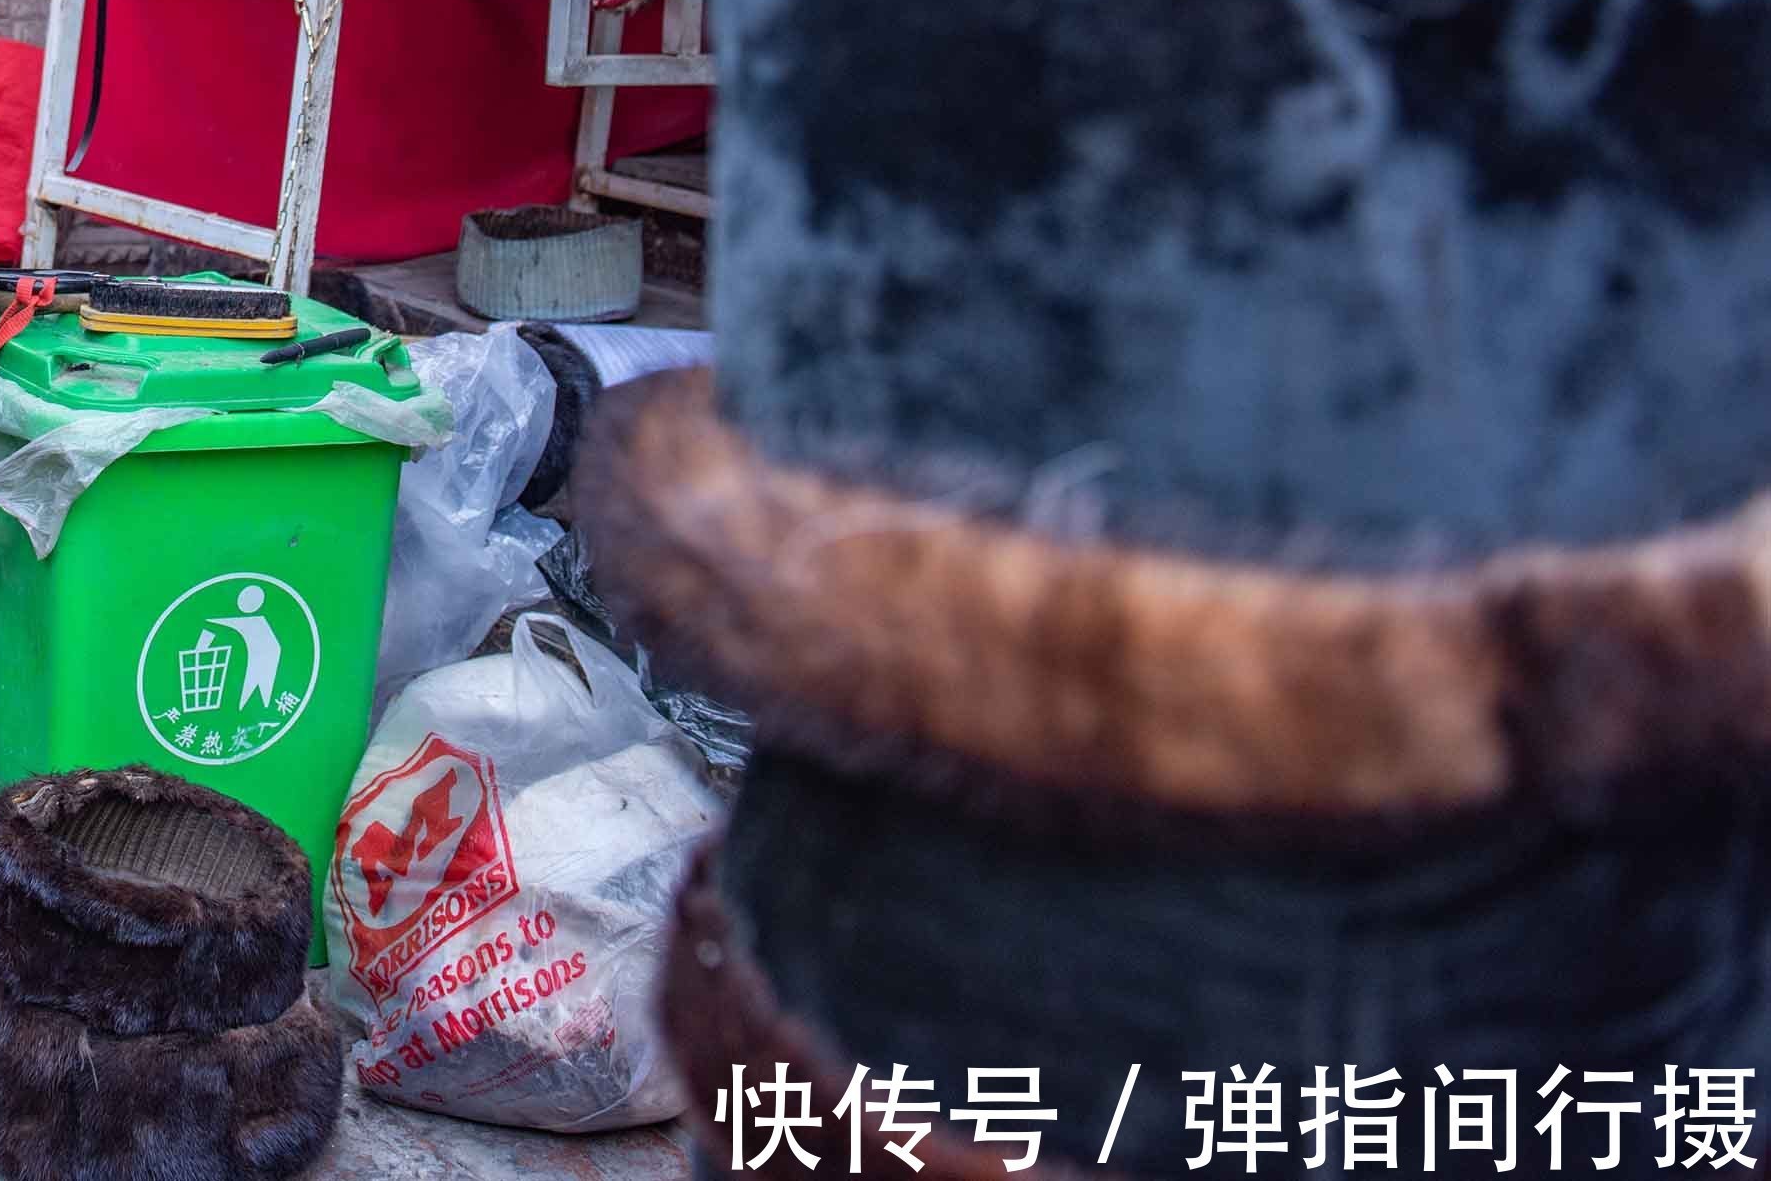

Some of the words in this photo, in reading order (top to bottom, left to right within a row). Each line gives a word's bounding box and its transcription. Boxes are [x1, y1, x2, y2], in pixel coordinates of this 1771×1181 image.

[518, 909, 556, 948] to
[397, 1031, 436, 1069] at
[431, 950, 588, 1055] Morrisons
